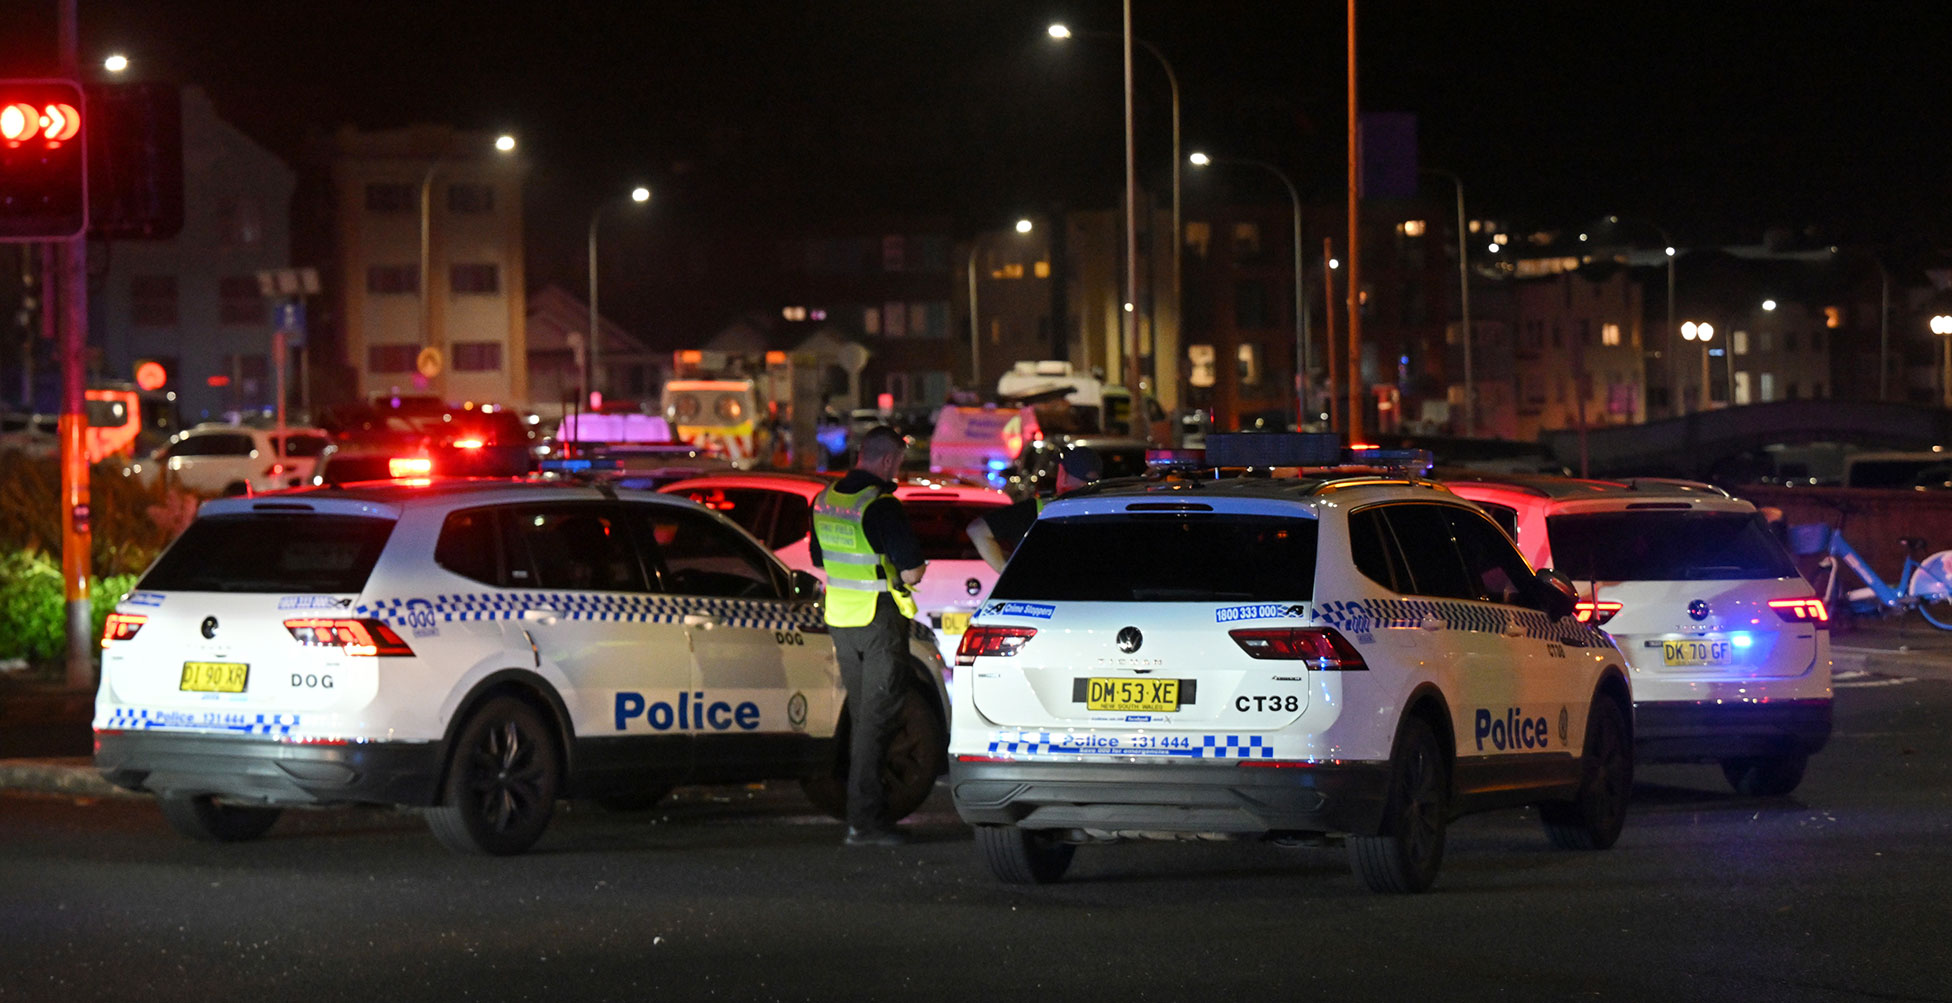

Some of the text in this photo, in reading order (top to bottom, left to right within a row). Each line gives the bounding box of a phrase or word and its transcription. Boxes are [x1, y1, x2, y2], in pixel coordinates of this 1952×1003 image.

[1005, 603, 1052, 617] Crime Stoppers
[1216, 605, 1277, 622] 1800 333 000
[775, 631, 804, 646] DOG
[1665, 642, 1729, 660] DK 70 GF
[206, 665, 223, 685] 90
[226, 665, 245, 685] XR
[291, 673, 334, 689] DOG
[1091, 682, 1175, 703] DM 53 XE
[615, 691, 761, 731] Police
[1235, 695, 1299, 712] CT38
[156, 711, 245, 724] Police 131 444
[1475, 707, 1548, 751] Police
[1062, 734, 1189, 748] Police 131 444
